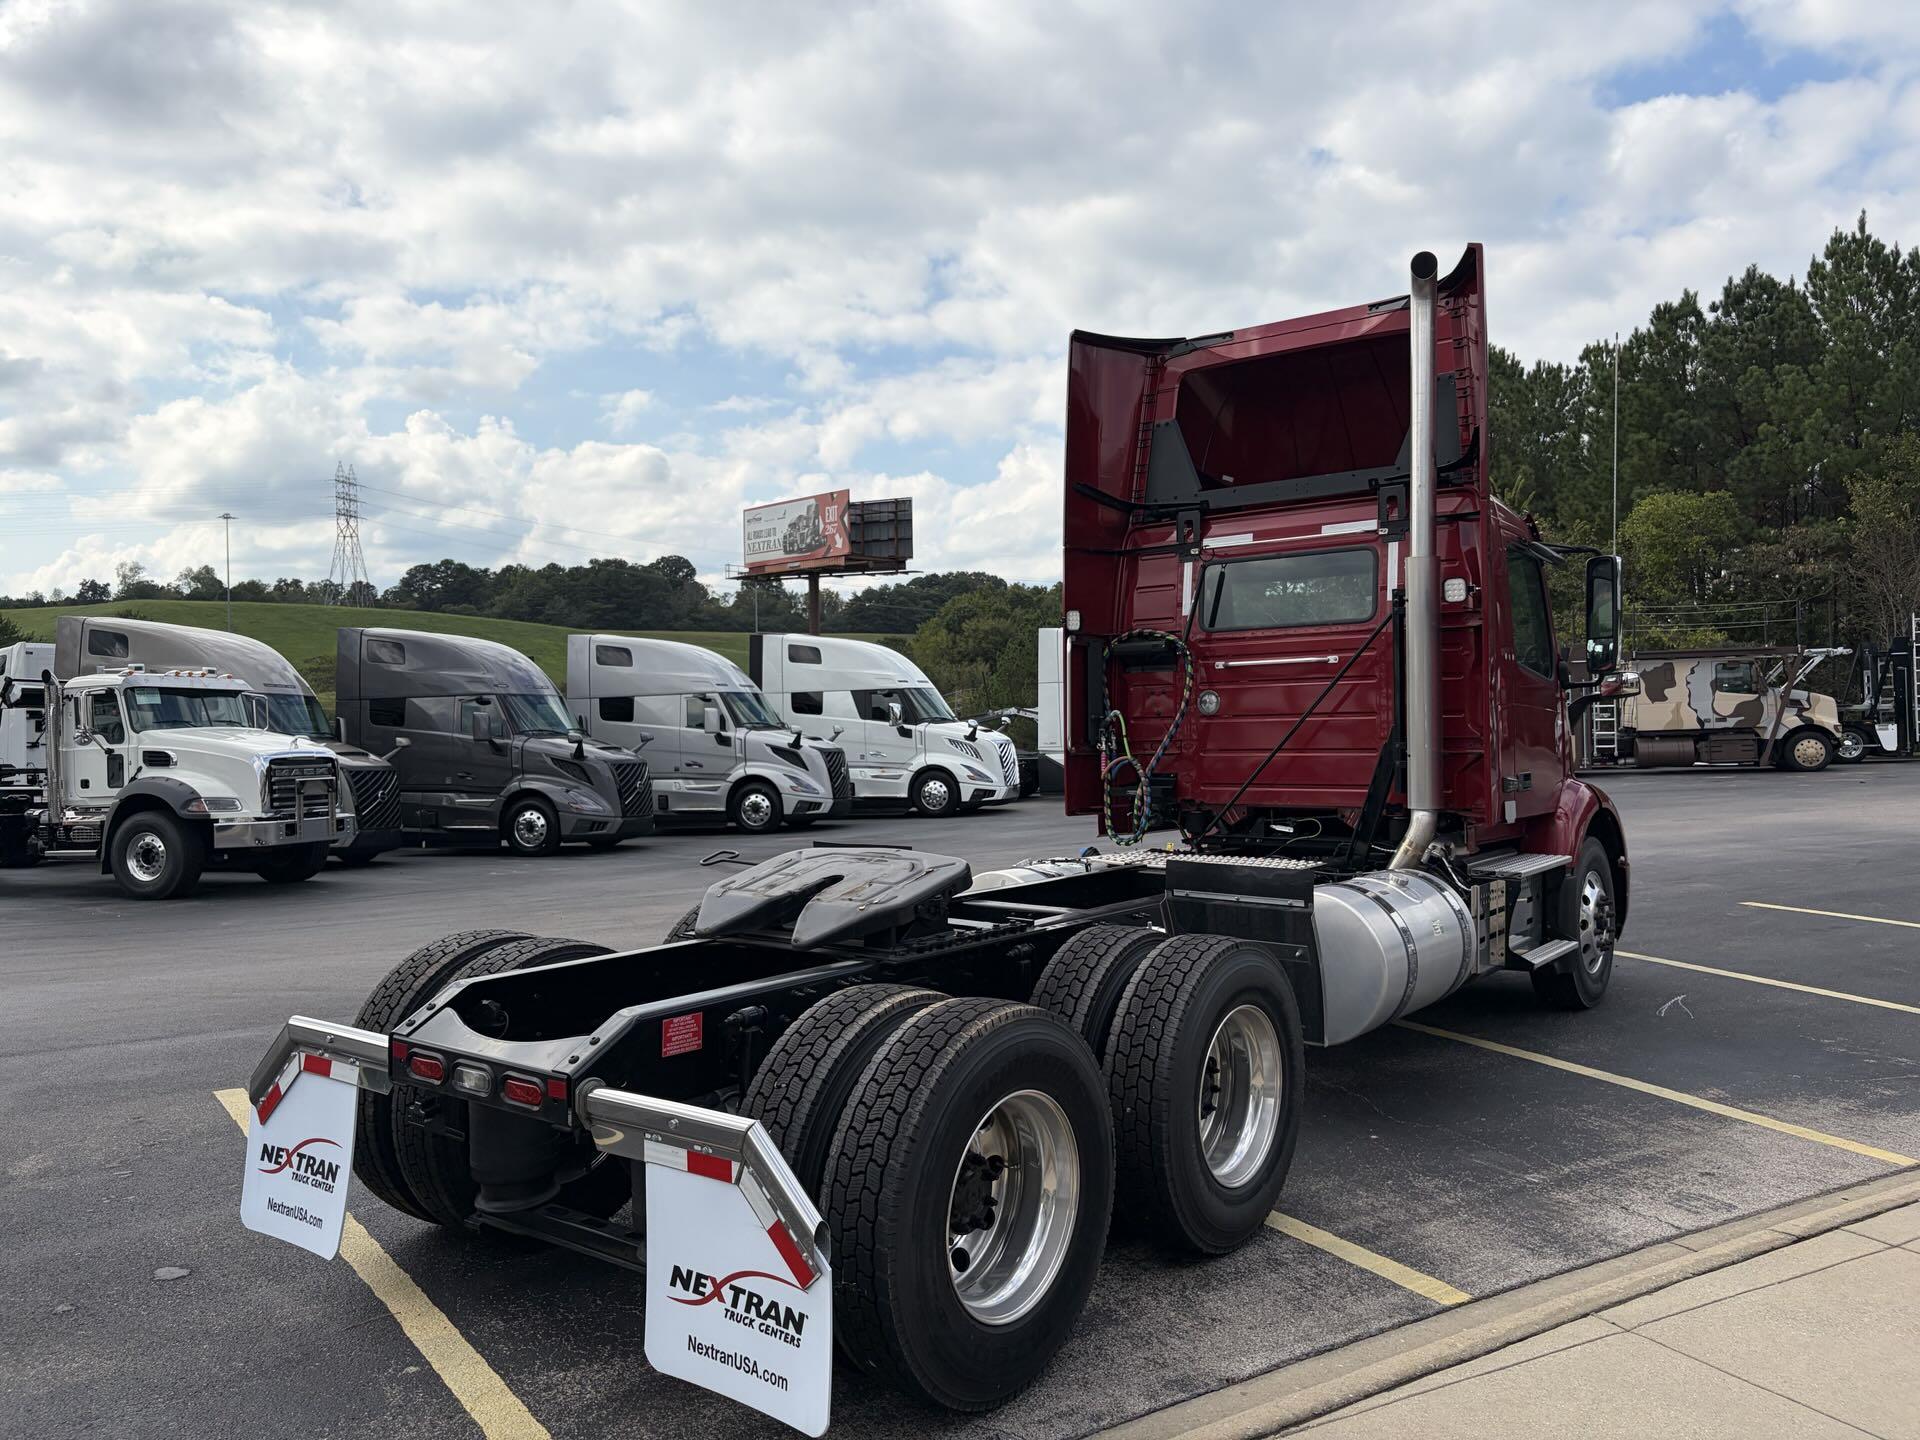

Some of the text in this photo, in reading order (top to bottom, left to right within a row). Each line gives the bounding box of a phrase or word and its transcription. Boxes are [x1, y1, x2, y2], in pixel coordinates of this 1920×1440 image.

[825, 505, 839, 523] EXIT
[825, 523, 839, 535] 267
[747, 537, 783, 553] NEXTRAN
[258, 1140, 342, 1184] NEXTRAN
[291, 1171, 335, 1194] TRUCK CENTERS
[267, 1196, 324, 1230] NextranUSA.com
[667, 1264, 807, 1336] NEXTRAN
[724, 1307, 802, 1349] TRUCK CENTERS
[687, 1334, 788, 1392] NextranUSA.com
